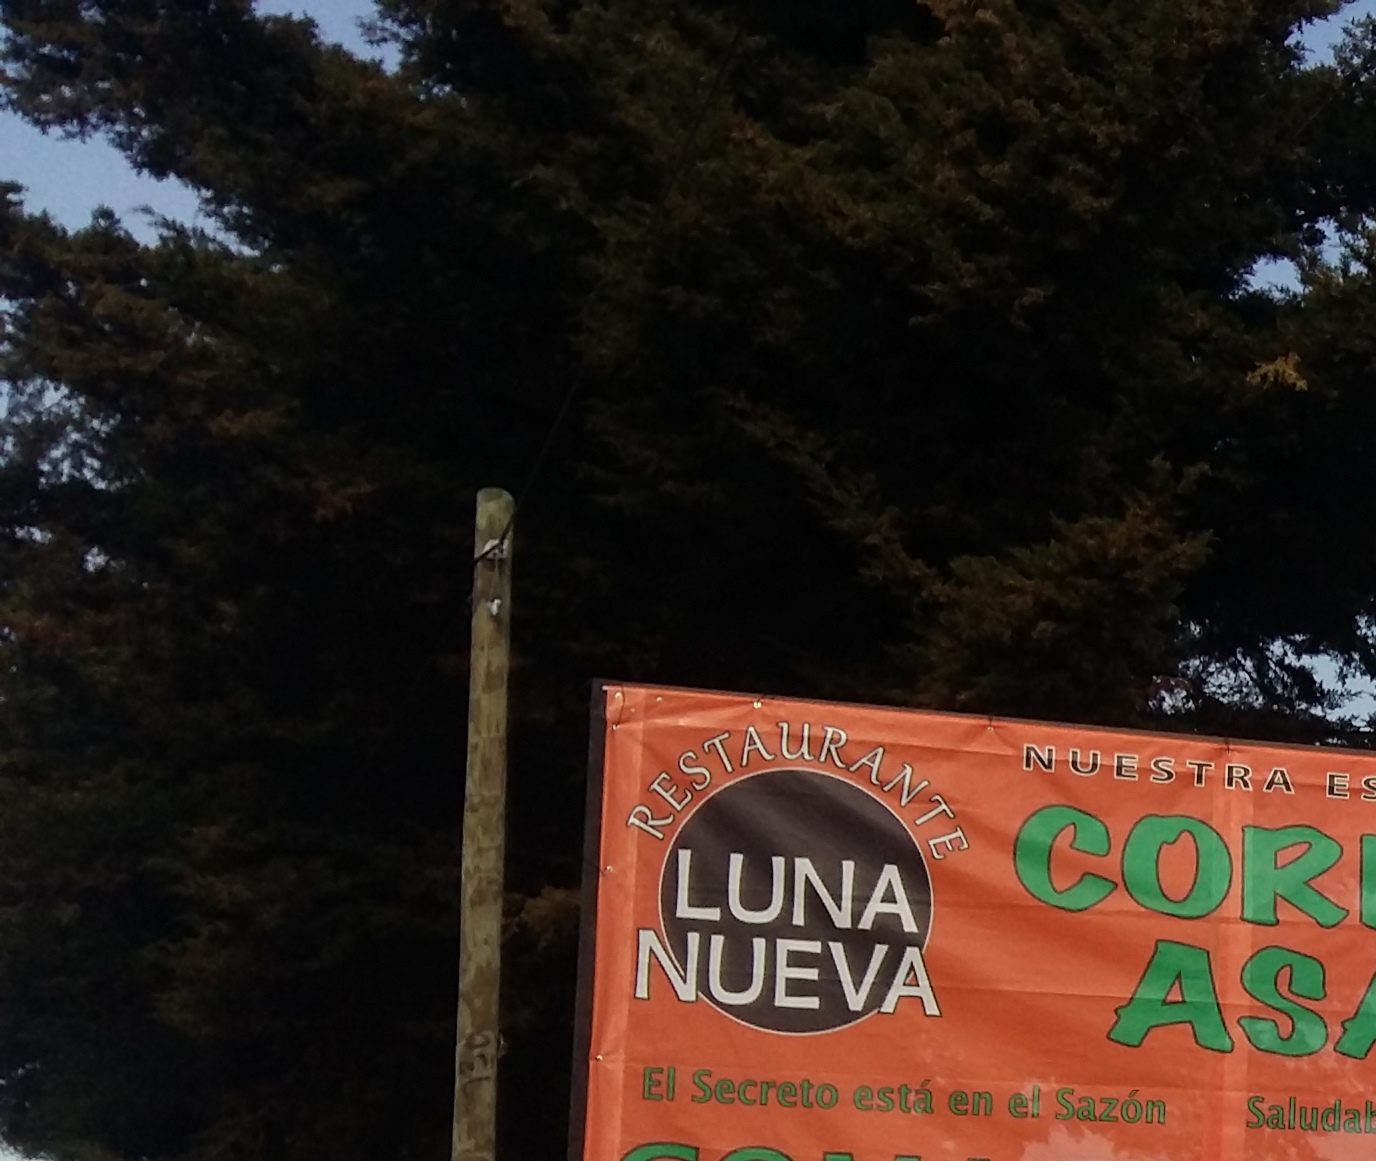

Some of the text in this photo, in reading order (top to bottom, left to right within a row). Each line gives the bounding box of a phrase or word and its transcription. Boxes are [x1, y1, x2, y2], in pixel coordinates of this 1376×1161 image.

[627, 721, 969, 860] RESTAURANTE
[1022, 743, 1295, 794] NUESTRA
[675, 849, 919, 934] LUNA
[634, 929, 942, 1017] NUEVA
[643, 1067, 1167, 1124] El Secreto está en el Sazón
